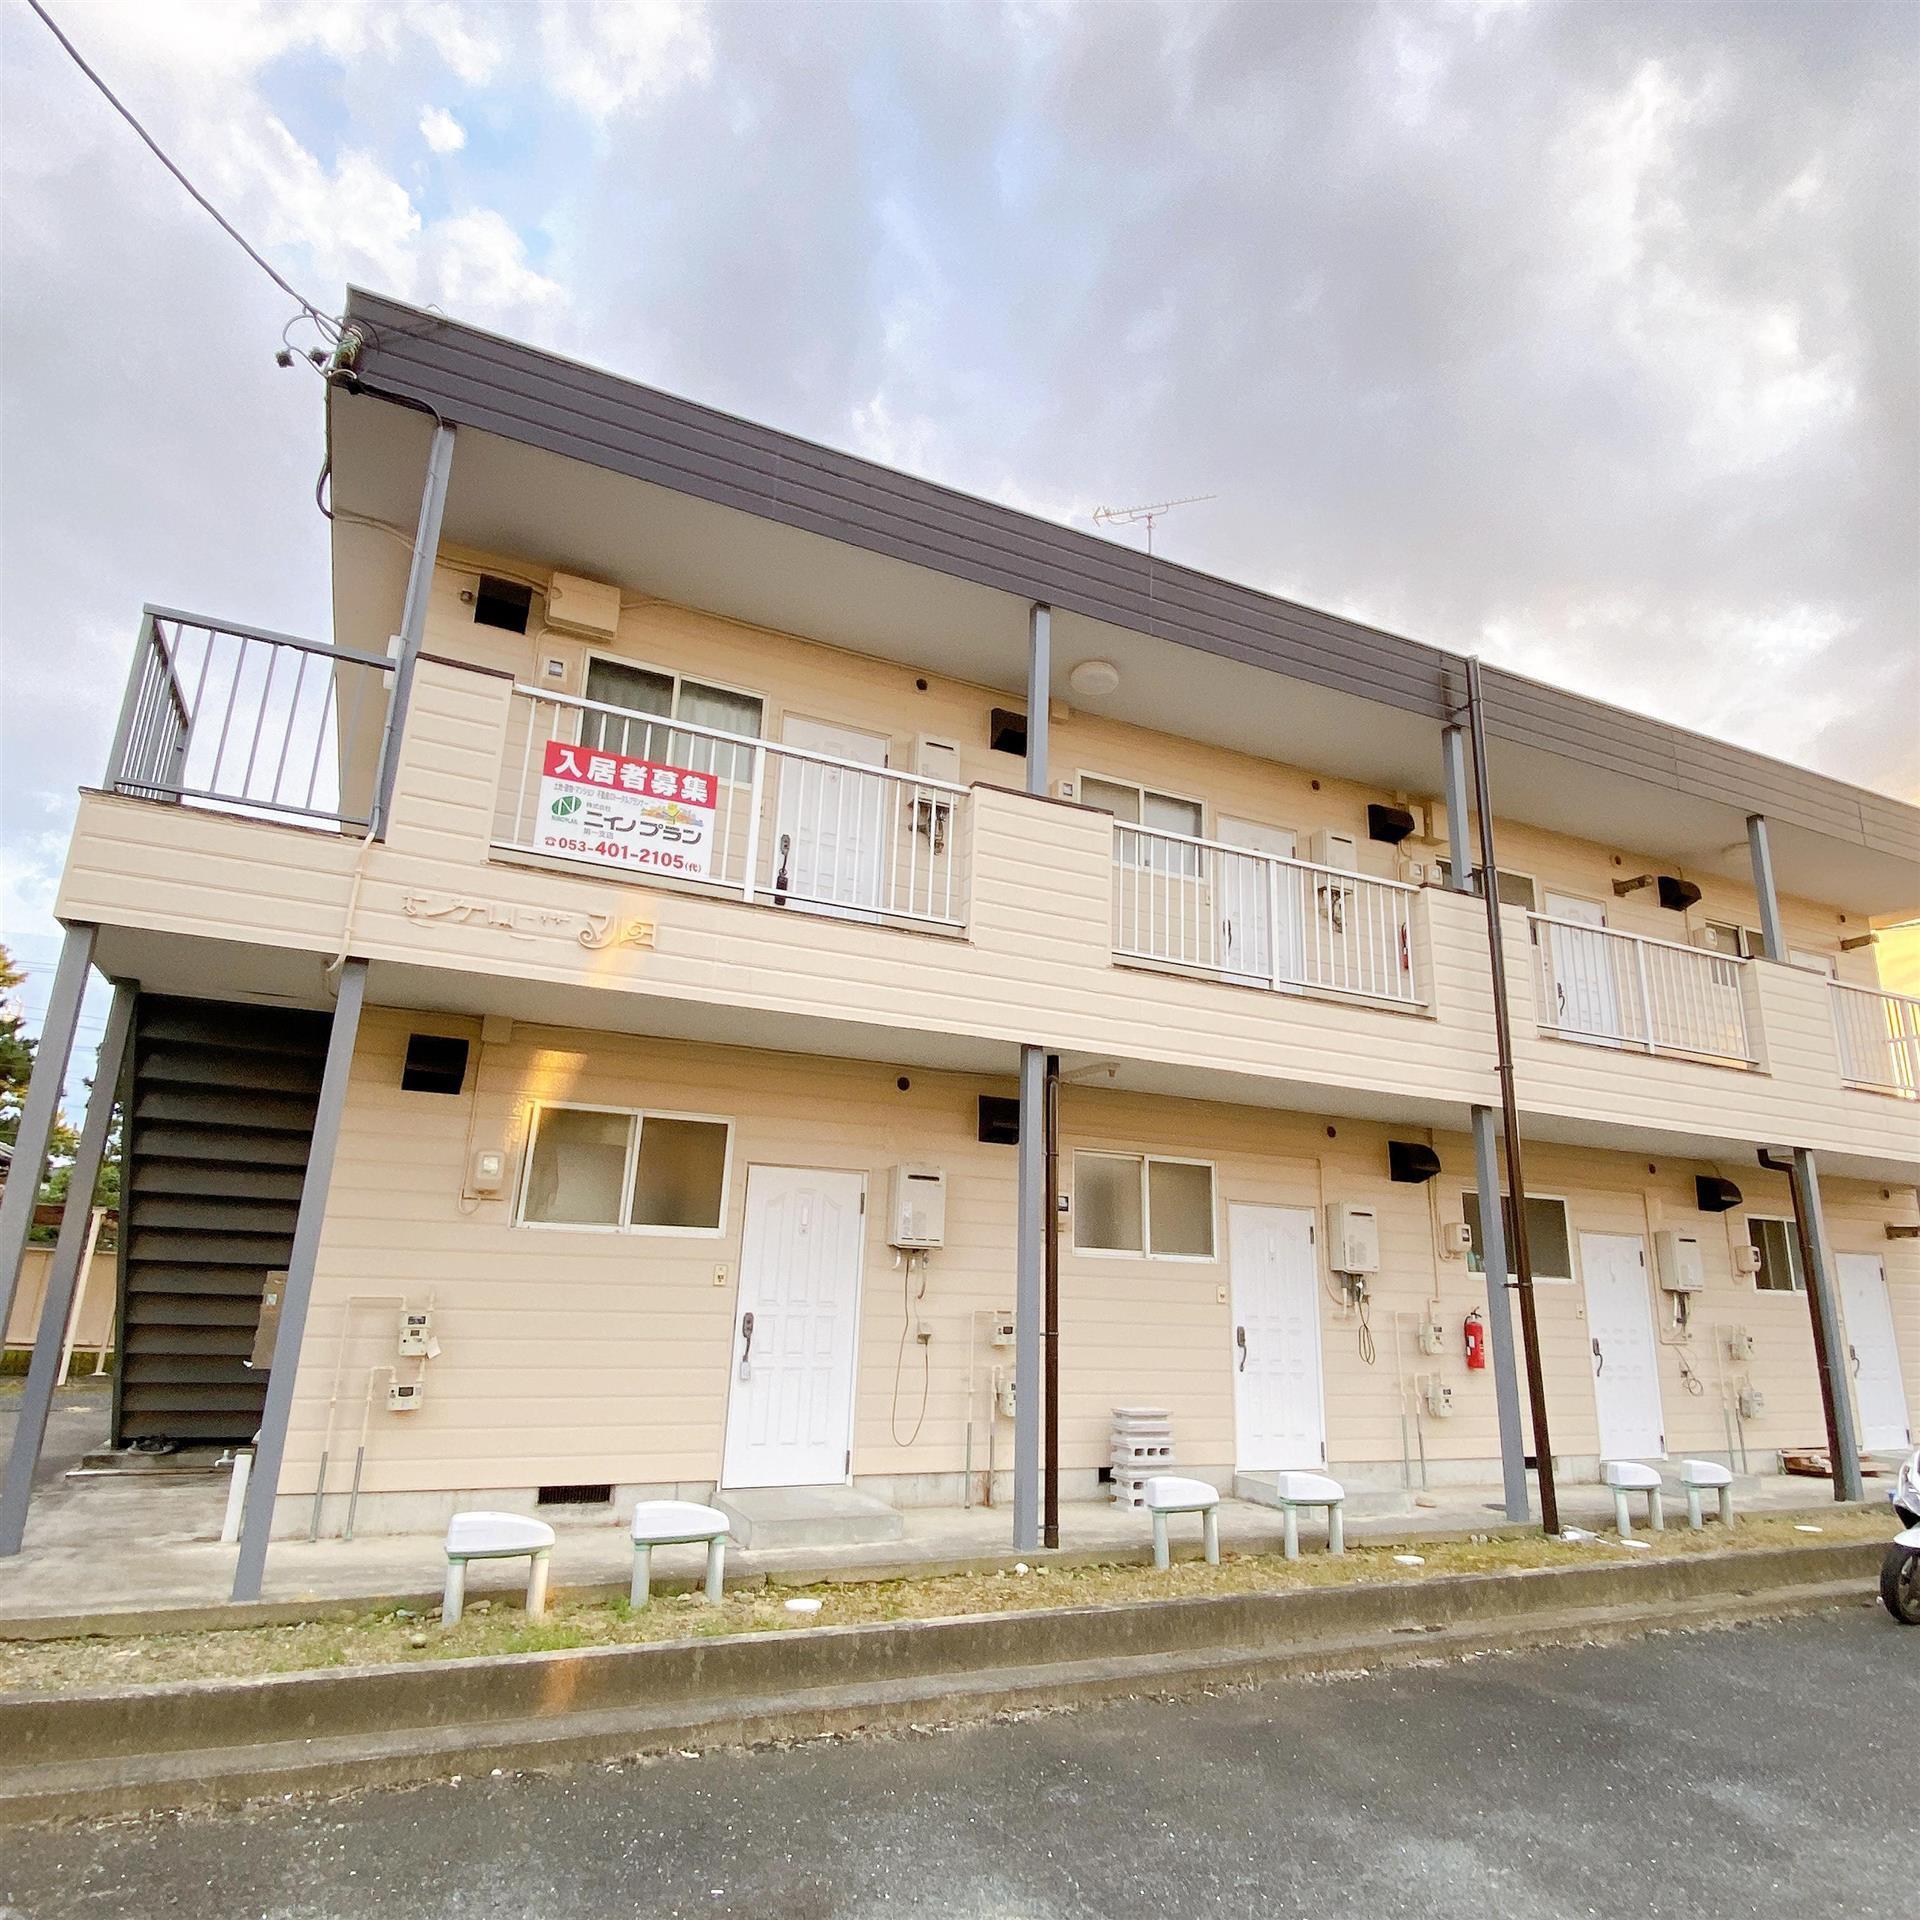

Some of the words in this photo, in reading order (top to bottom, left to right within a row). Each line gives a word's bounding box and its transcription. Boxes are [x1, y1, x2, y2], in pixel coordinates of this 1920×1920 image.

[554, 749, 708, 803] 入居者募集
